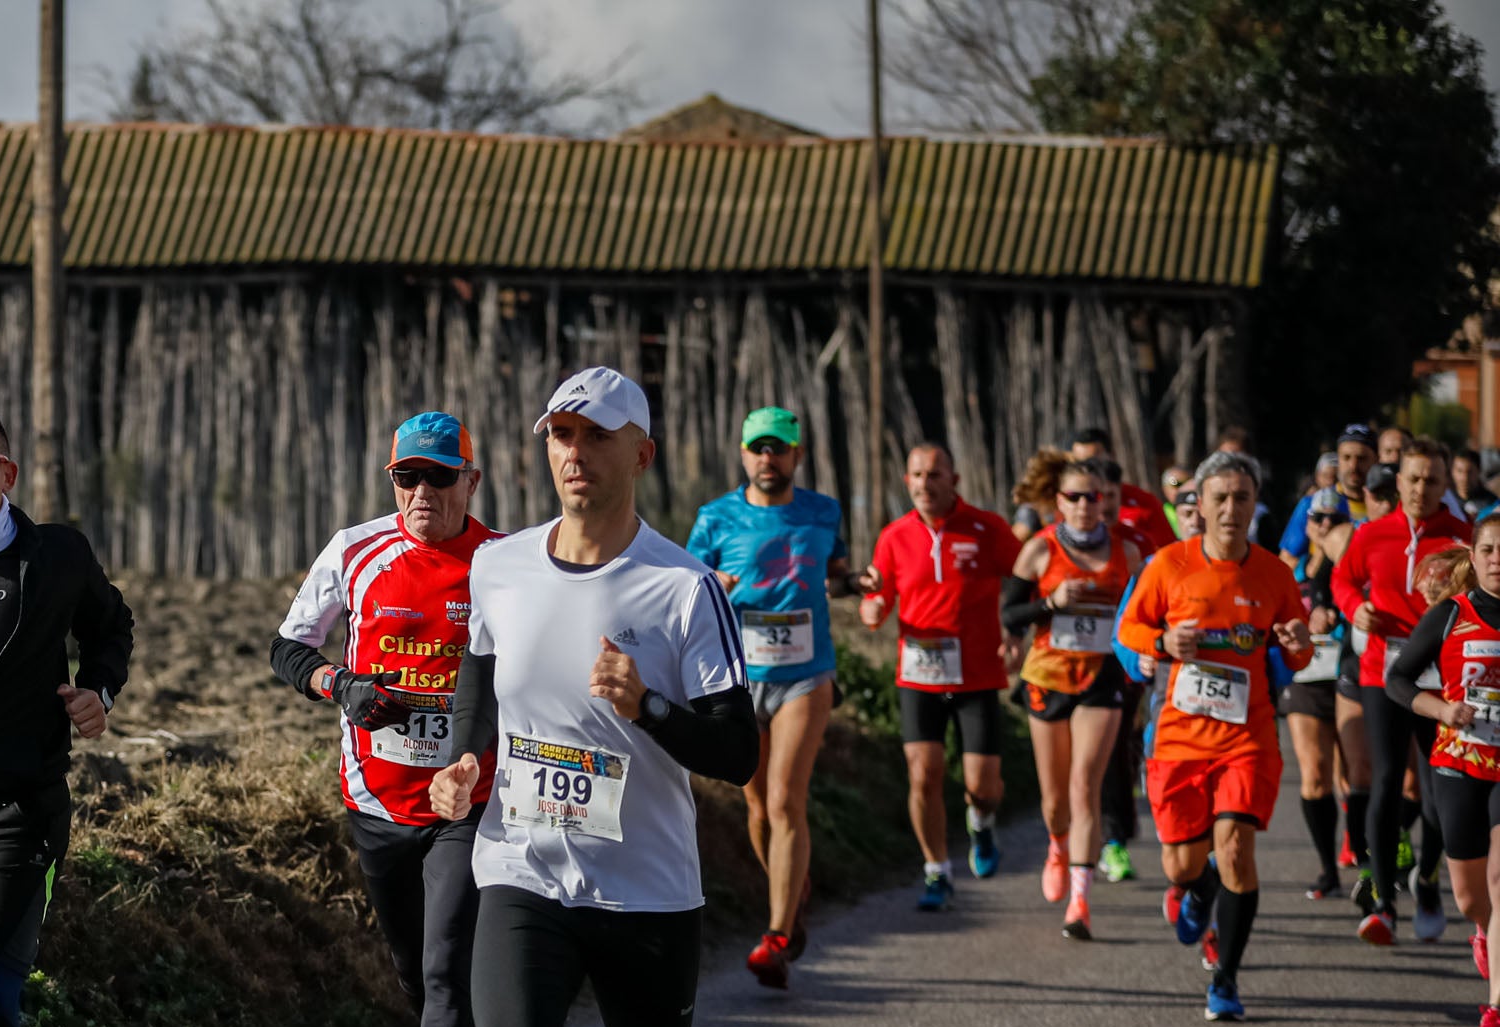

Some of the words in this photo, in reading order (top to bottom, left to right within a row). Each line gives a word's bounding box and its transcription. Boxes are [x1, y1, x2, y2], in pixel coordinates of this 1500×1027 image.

[766, 626, 792, 645] 32
[1194, 678, 1231, 699] 154
[403, 738, 440, 751] ALCOTAN
[538, 742, 581, 757] CARRERA
[538, 750, 581, 763] POPULAR
[533, 767, 592, 805] 199
[536, 799, 557, 814] JOSE
[560, 802, 588, 818] DAVID
